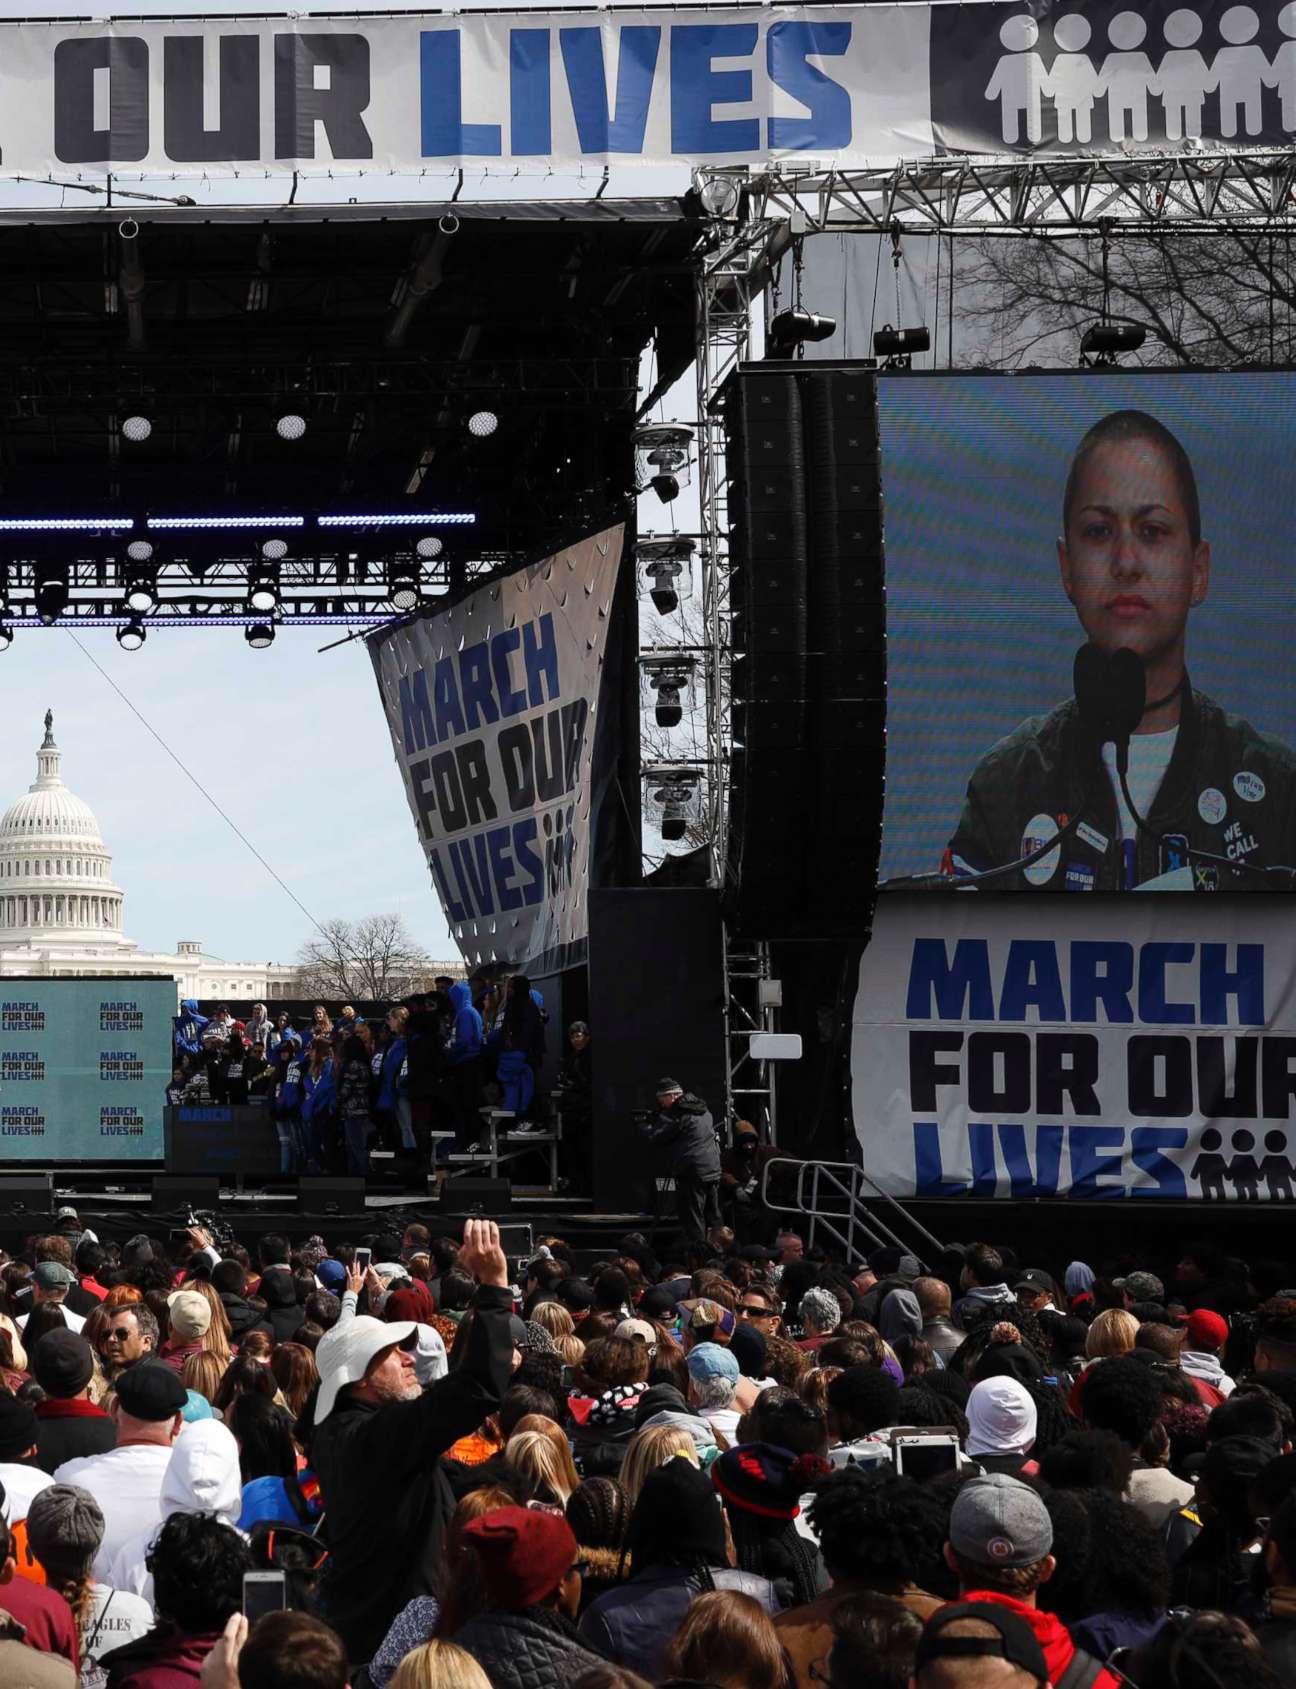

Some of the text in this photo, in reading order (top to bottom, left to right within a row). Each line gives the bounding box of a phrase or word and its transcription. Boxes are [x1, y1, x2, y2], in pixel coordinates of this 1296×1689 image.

[54, 33, 373, 163] OUR
[420, 21, 853, 157] LIVES
[400, 612, 560, 755] MARCH
[409, 697, 589, 840] FOR OUR
[1224, 821, 1243, 842] WE
[1227, 834, 1259, 860] CALL
[429, 816, 545, 923] LIVES
[906, 938, 1265, 1026] MARCH
[2, 1002, 38, 1011] MARCH
[100, 1002, 136, 1011] MARCH
[2, 1012, 44, 1021] FOR OUR
[100, 1012, 143, 1021] FOR OUR
[2, 1022, 30, 1031] LIVES
[100, 1022, 128, 1031] LIVES
[2, 1052, 38, 1060] MARCH
[100, 1052, 136, 1060] MARCH
[2, 1062, 44, 1070] FOR OUR
[100, 1062, 143, 1070] FOR OUR
[2, 1072, 30, 1080] LIVES
[100, 1072, 128, 1080] LIVES
[909, 1031, 1296, 1119] FOR OUR
[2, 1107, 38, 1116] MARCH
[100, 1107, 136, 1116] MARCH
[2, 1116, 44, 1126] FOR OUR
[100, 1116, 143, 1126] FOR OUR
[2, 1126, 30, 1136] LIVES
[100, 1126, 128, 1136] LIVES
[913, 1122, 1189, 1198] LIVES
